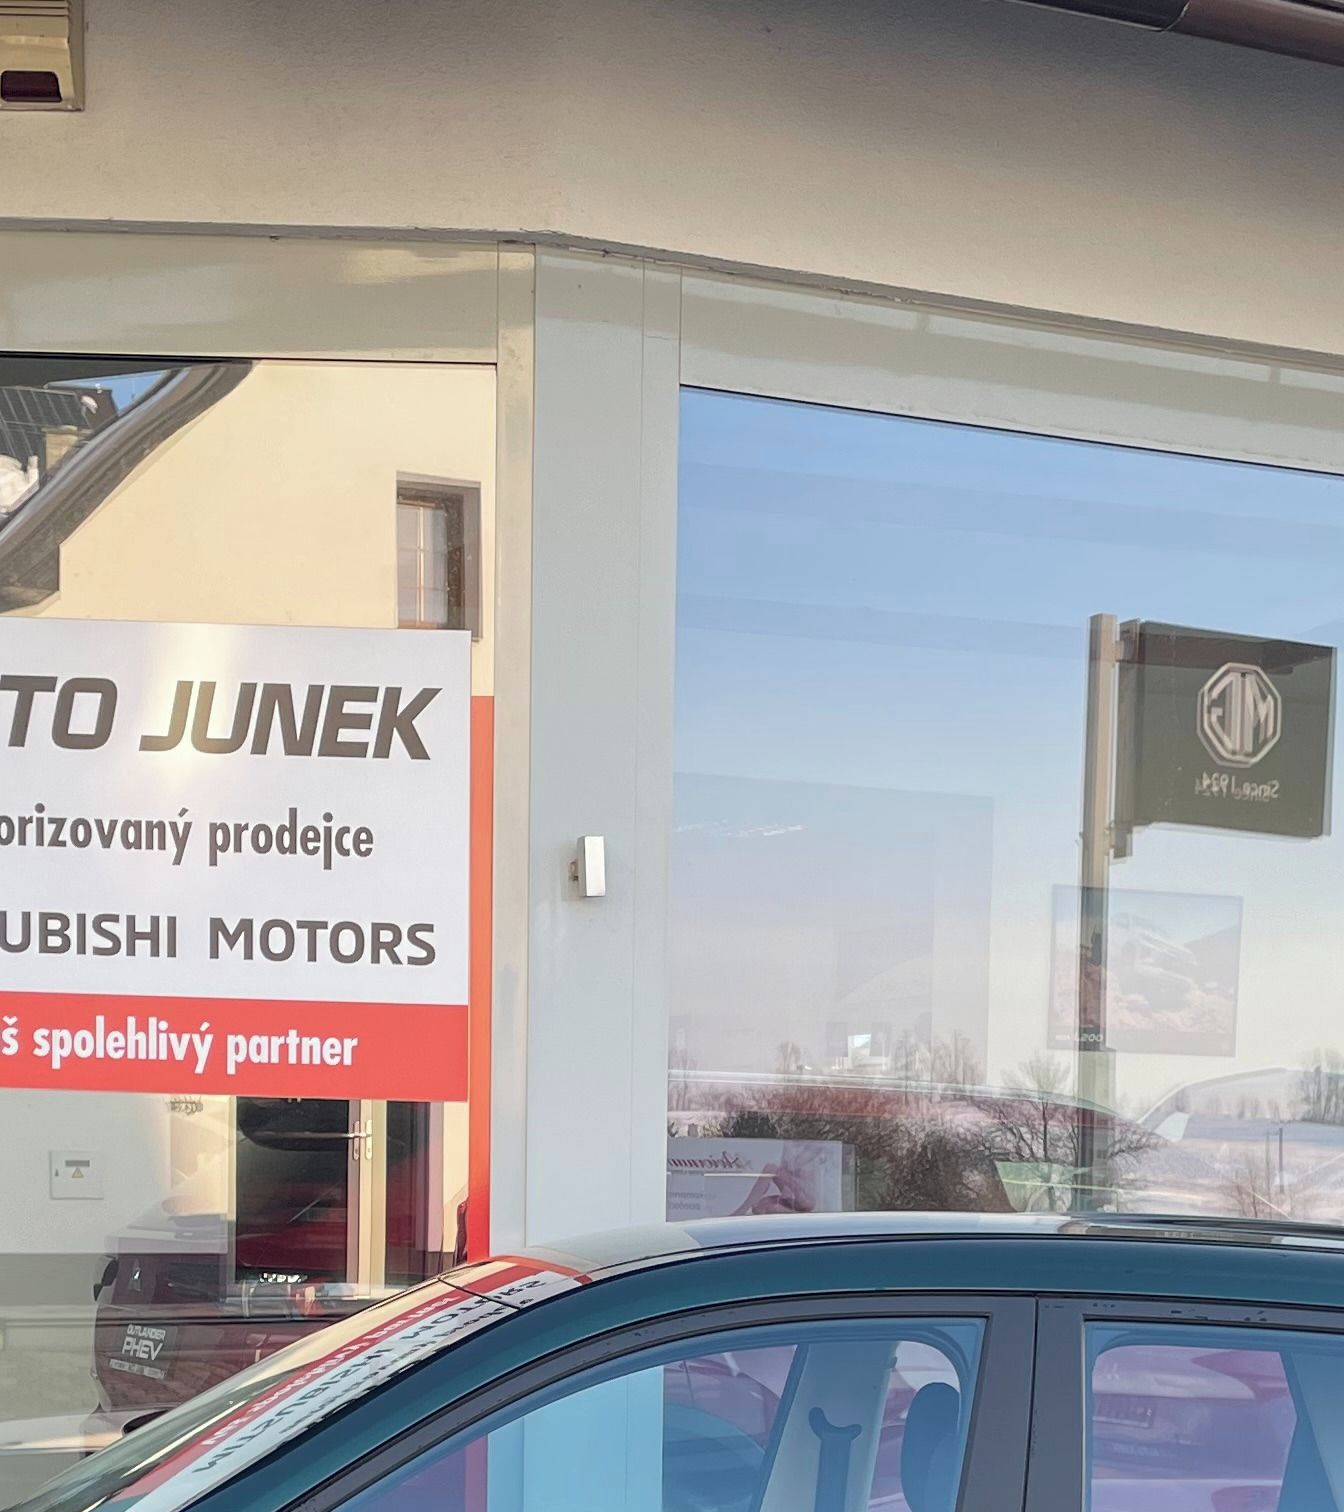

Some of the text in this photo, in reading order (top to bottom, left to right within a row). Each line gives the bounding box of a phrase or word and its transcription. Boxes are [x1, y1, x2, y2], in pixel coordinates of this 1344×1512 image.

[139, 681, 443, 761] JUNEK
[208, 808, 374, 871] prodejce
[209, 917, 436, 966] MOTORS
[33, 1016, 214, 1074] spolehlivý
[226, 1030, 359, 1074] partner
[121, 1336, 163, 1361] PHEV
[126, 1323, 166, 1341] OUTLANDER
